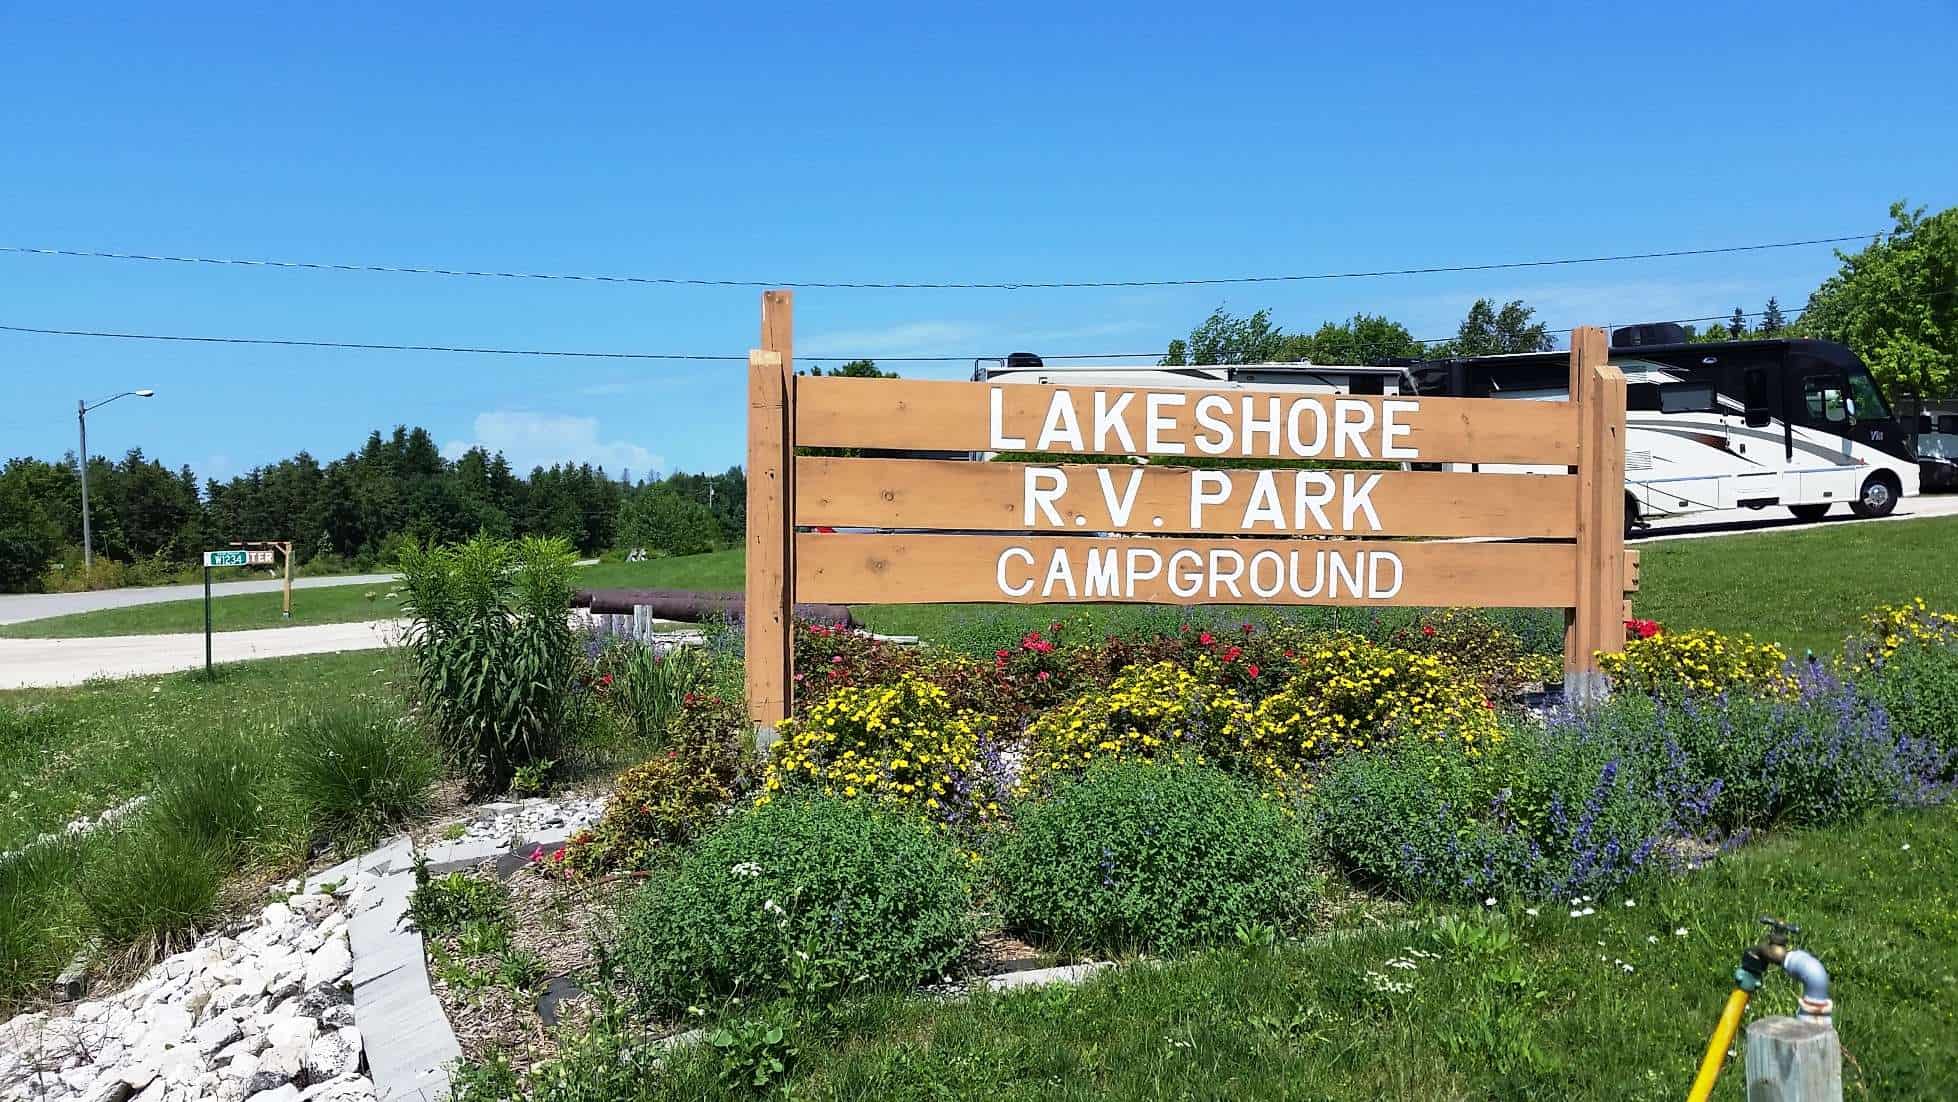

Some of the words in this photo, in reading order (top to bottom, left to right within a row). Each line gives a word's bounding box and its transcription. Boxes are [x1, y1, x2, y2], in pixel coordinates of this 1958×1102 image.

[990, 388, 1420, 459] LAKESHORE
[1024, 466, 1165, 528] R.V.
[1190, 469, 1384, 531] PARK
[250, 552, 273, 563] TER
[997, 547, 1403, 600] CAMPGROUND
